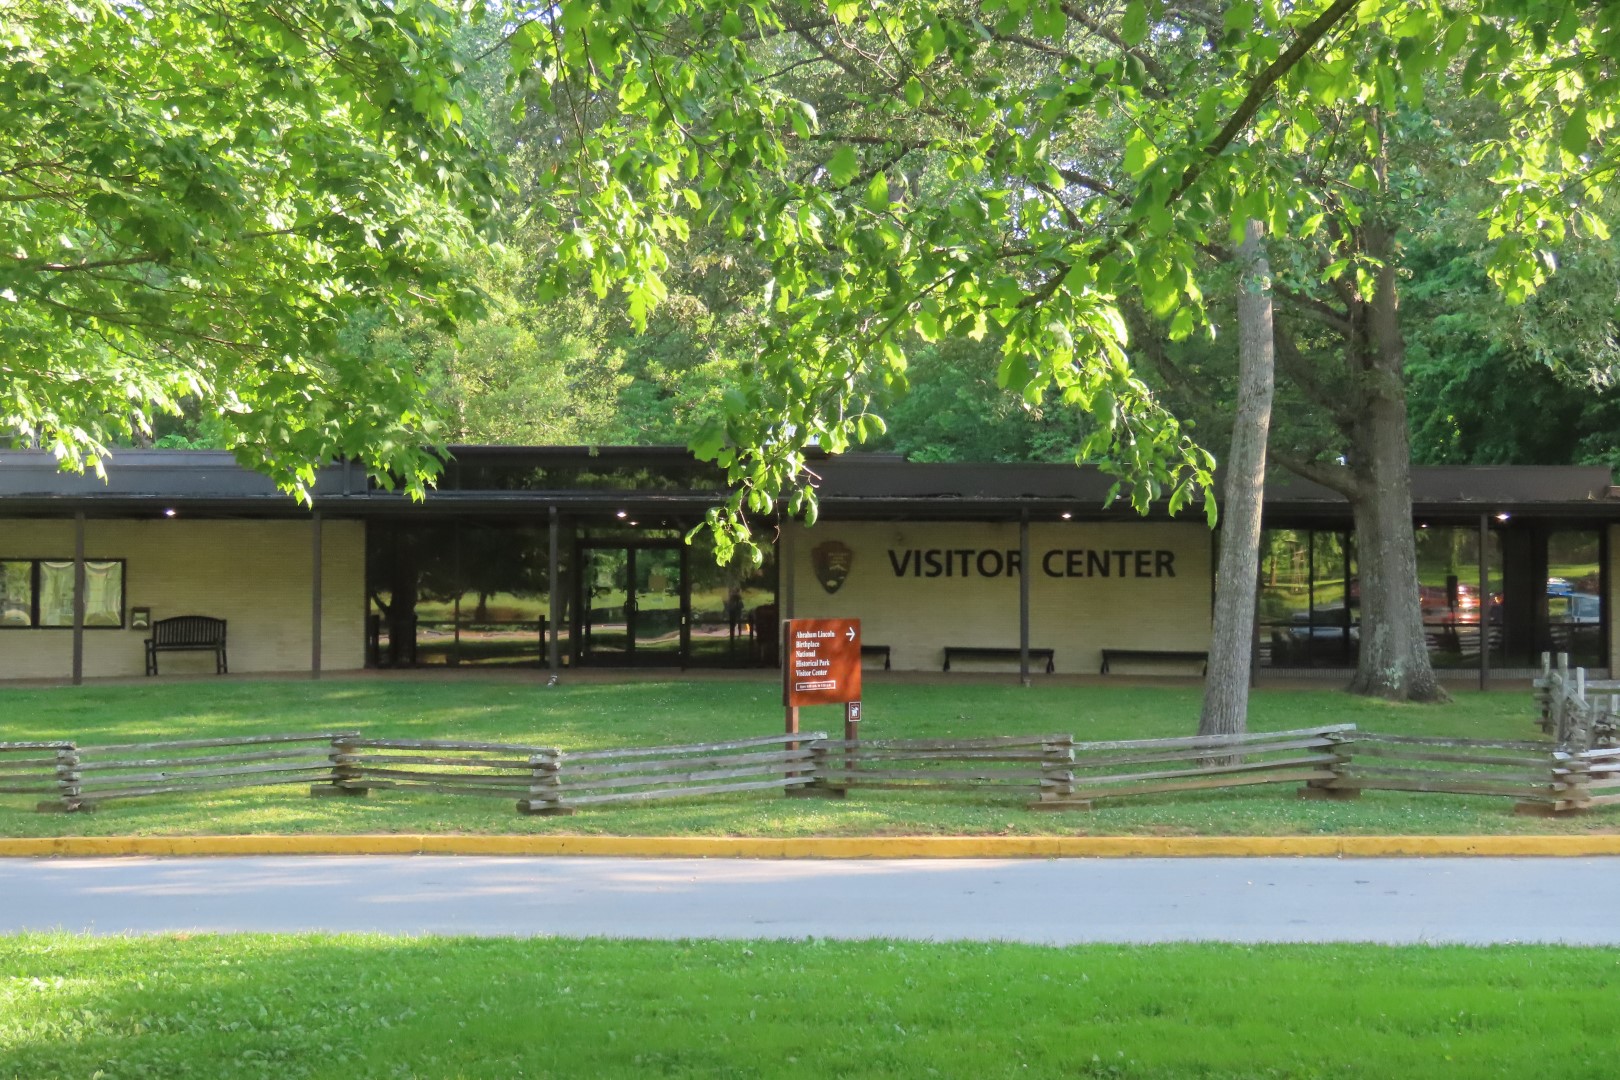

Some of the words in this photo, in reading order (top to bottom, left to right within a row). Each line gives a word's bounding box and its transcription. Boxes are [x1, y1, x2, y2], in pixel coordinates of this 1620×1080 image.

[888, 549, 1021, 578] VISITOR
[1042, 549, 1176, 578] CENTER
[796, 631, 817, 639] Abraham
[818, 630, 835, 638] Lincoln
[796, 641, 820, 649] Birthplace
[796, 650, 816, 658] National
